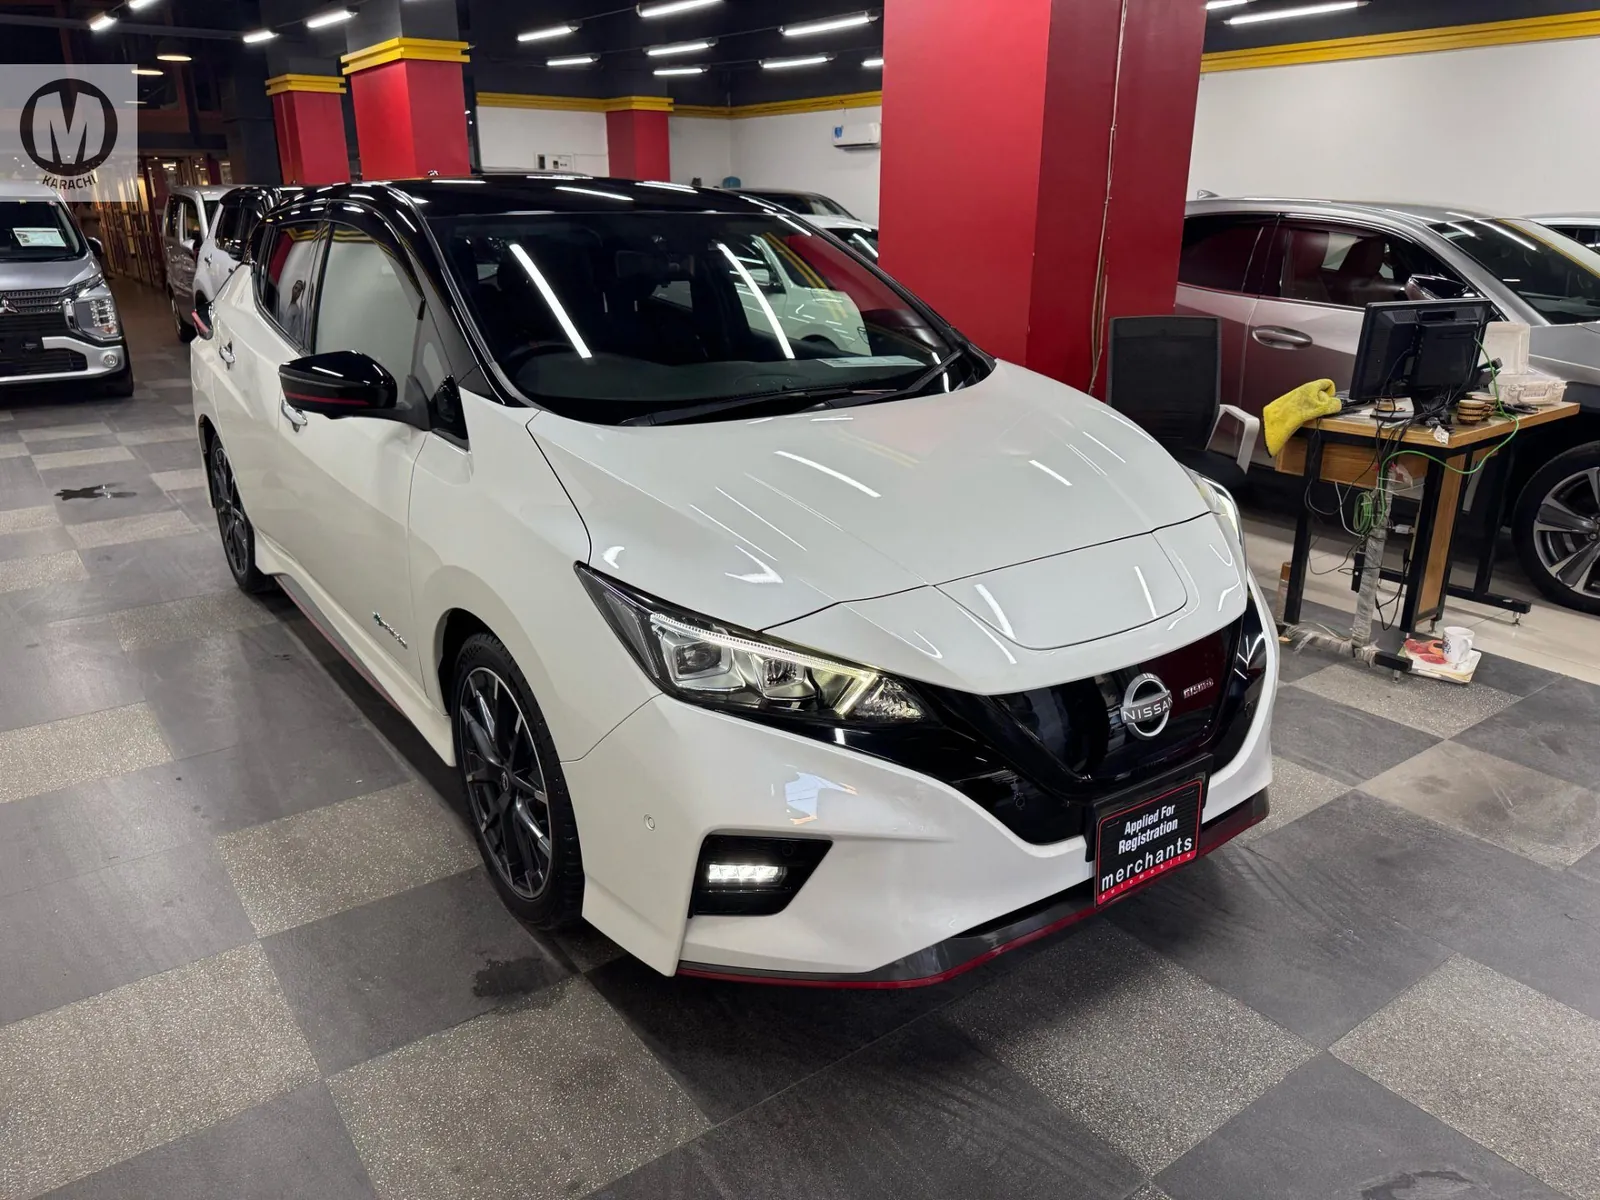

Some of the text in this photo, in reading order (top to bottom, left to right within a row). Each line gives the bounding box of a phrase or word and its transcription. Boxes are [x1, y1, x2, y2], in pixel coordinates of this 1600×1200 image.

[1123, 696, 1173, 721] NISSAN
[1118, 818, 1178, 855] Registration
[1124, 804, 1176, 836] Applied For
[1101, 837, 1192, 892] merchants
